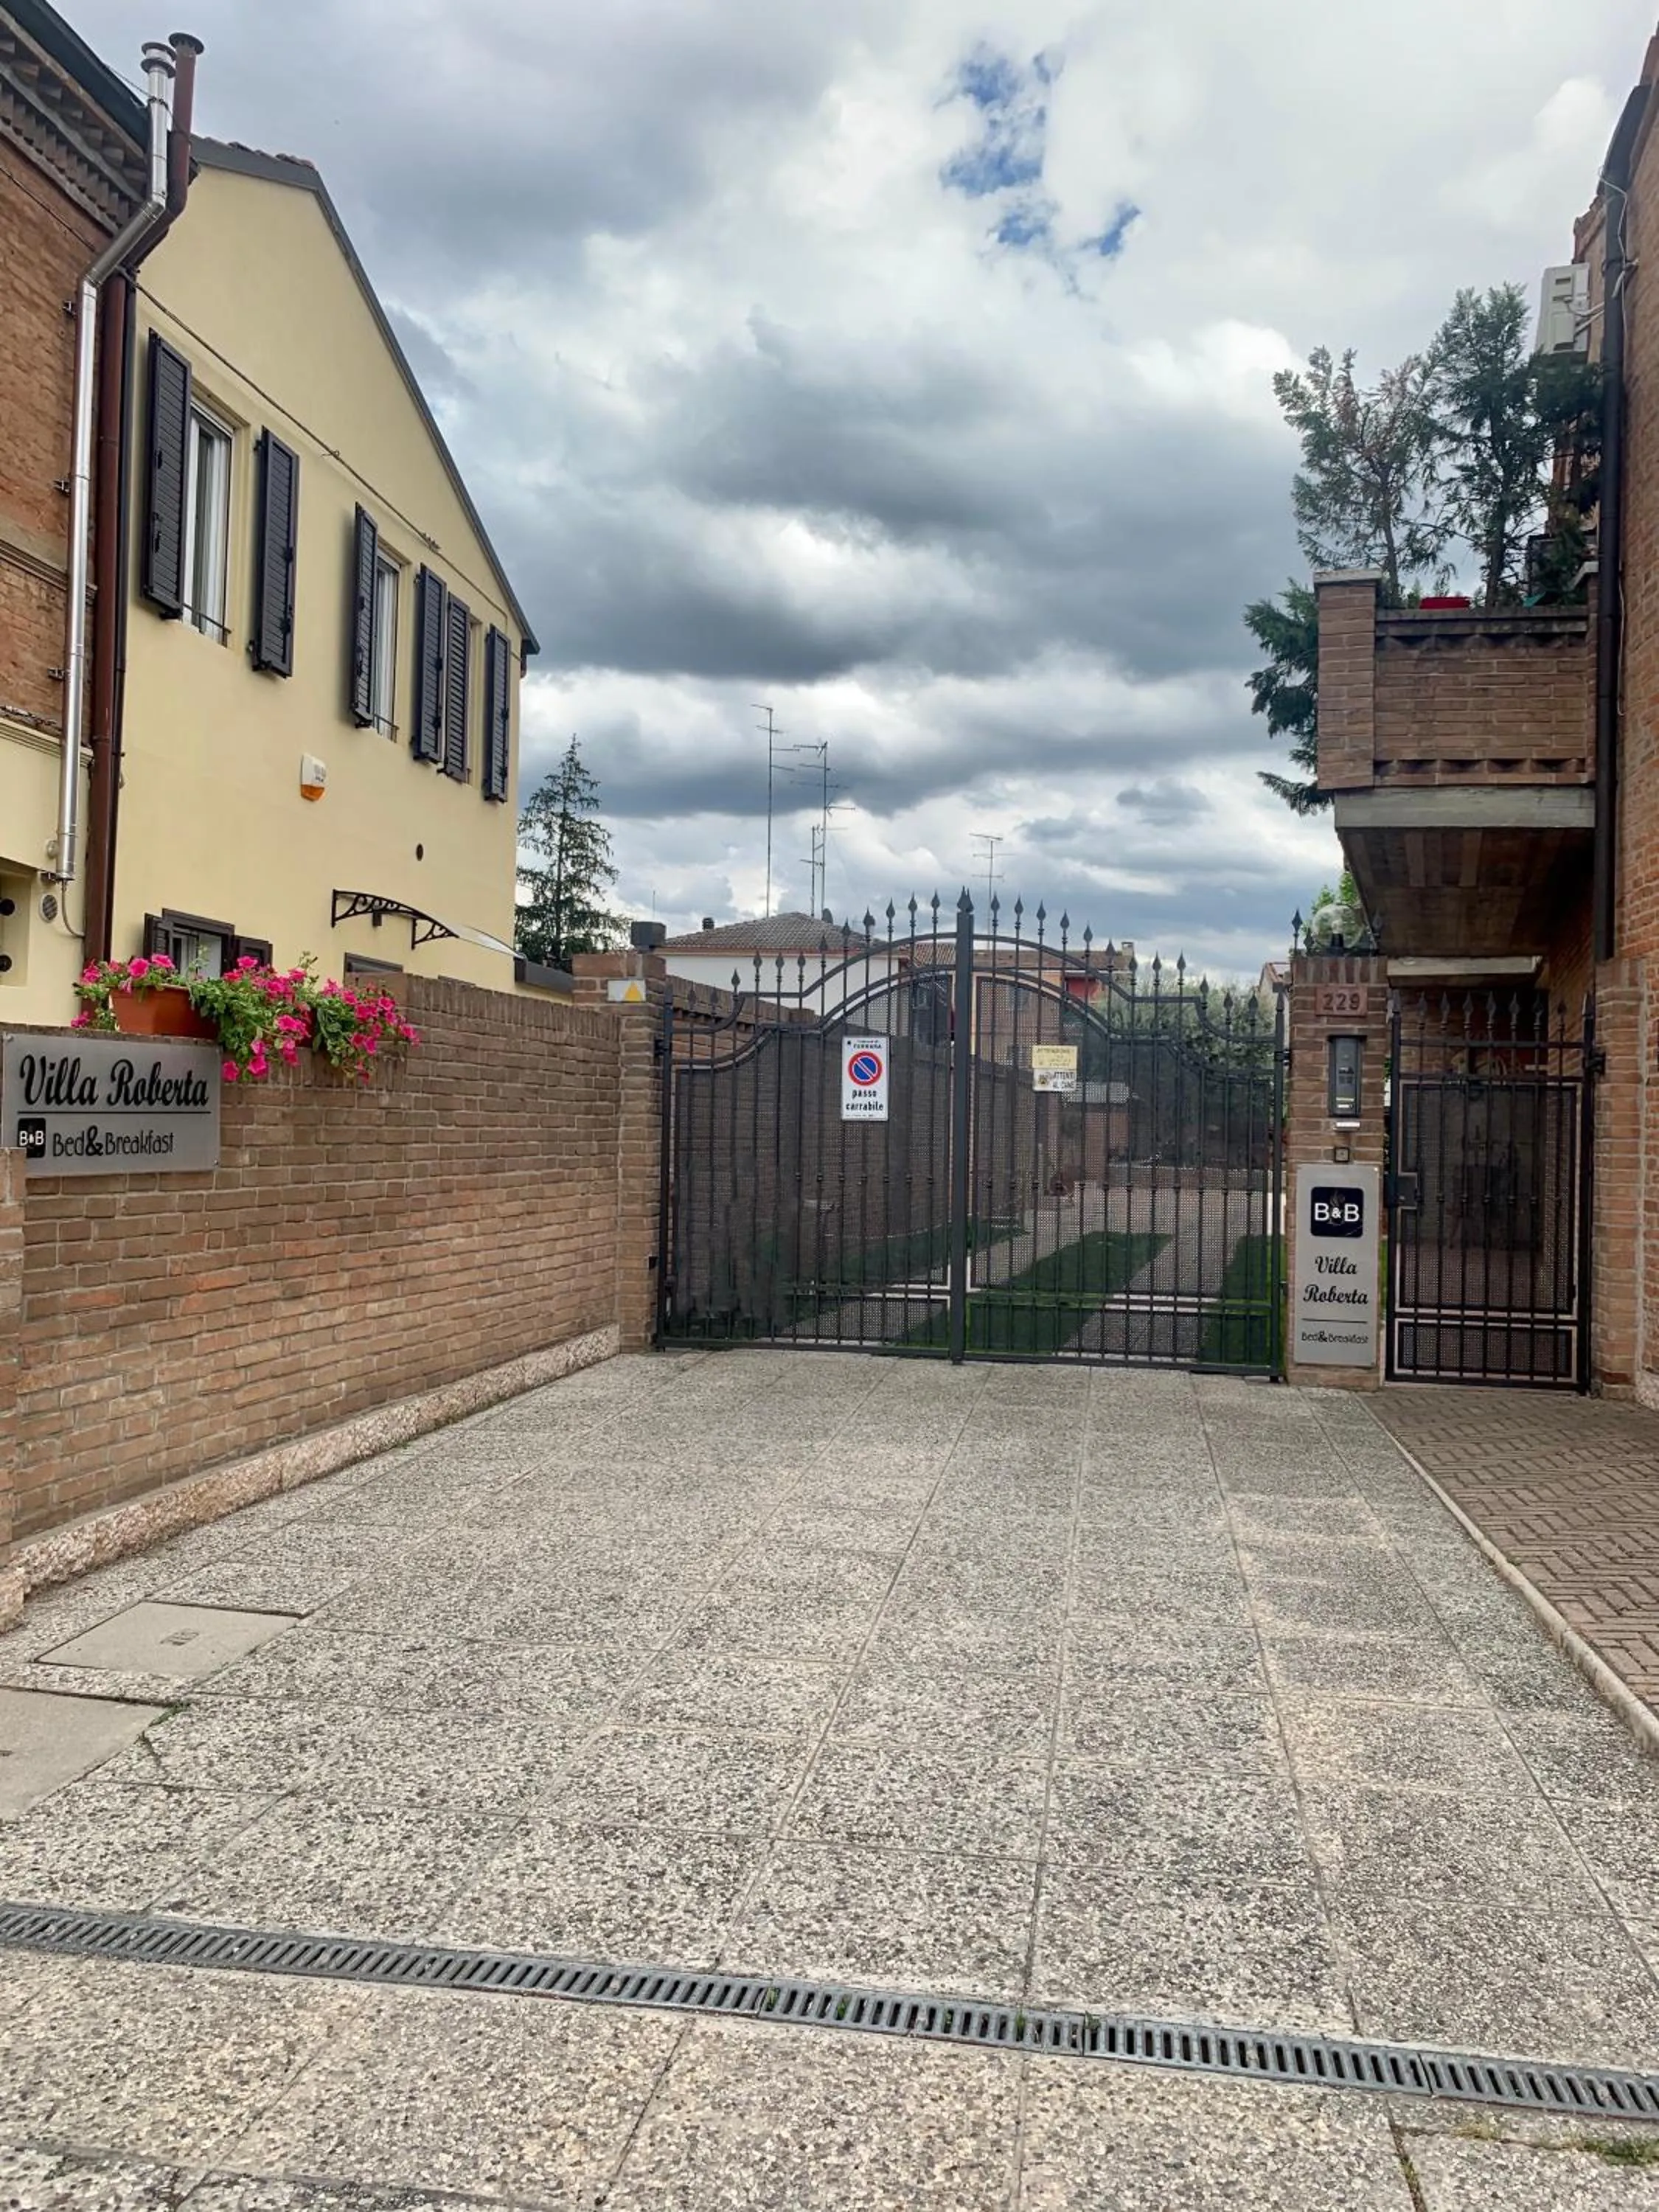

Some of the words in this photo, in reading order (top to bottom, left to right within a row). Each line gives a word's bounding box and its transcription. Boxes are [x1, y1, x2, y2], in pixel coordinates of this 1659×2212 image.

[1324, 993, 1360, 1011] 229
[20, 1054, 98, 1105] Villa
[107, 1059, 209, 1106] Roberta
[852, 1089, 877, 1099] passo
[846, 1101, 883, 1111] carrabile
[52, 1125, 174, 1157] Bed&Breakfast
[1314, 1203, 1360, 1222] B&B
[1315, 1256, 1357, 1275] Villa
[1303, 1284, 1368, 1304] Roberta
